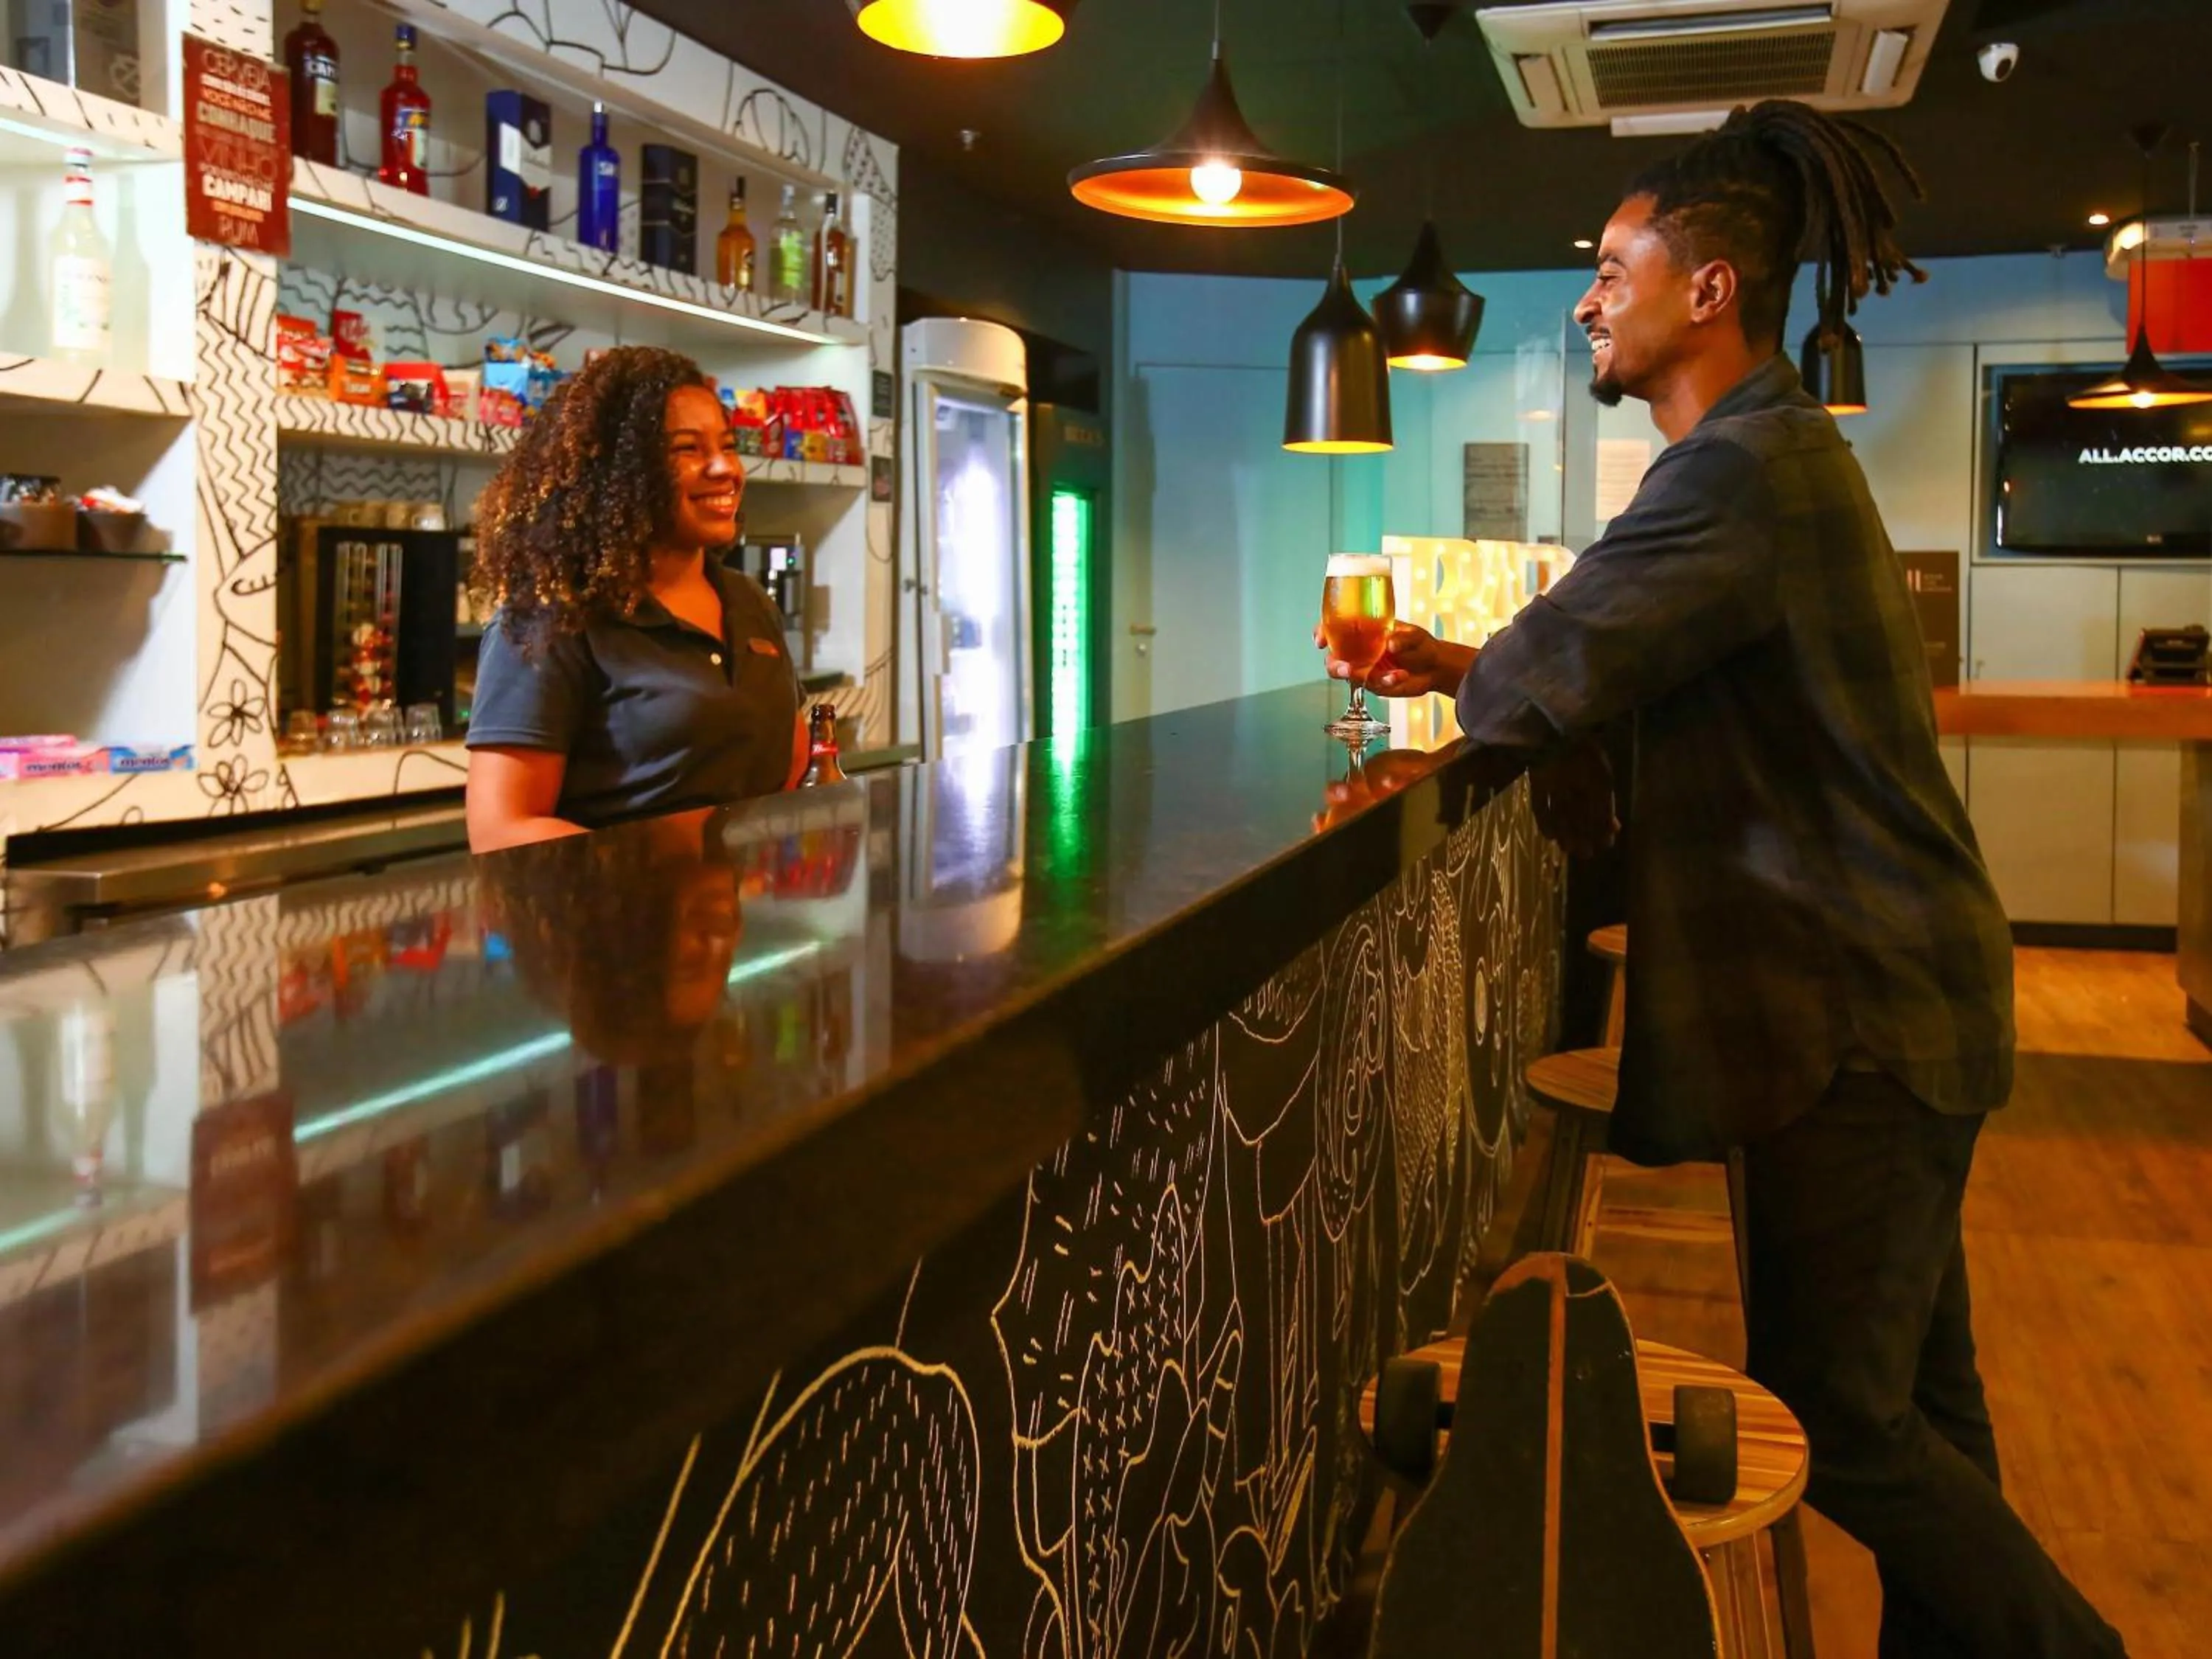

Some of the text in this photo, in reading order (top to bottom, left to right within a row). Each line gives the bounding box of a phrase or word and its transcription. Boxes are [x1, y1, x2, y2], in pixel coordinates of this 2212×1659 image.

[195, 134, 278, 181] VINHO
[203, 173, 272, 212] CAMPARI
[219, 214, 259, 246] RUM
